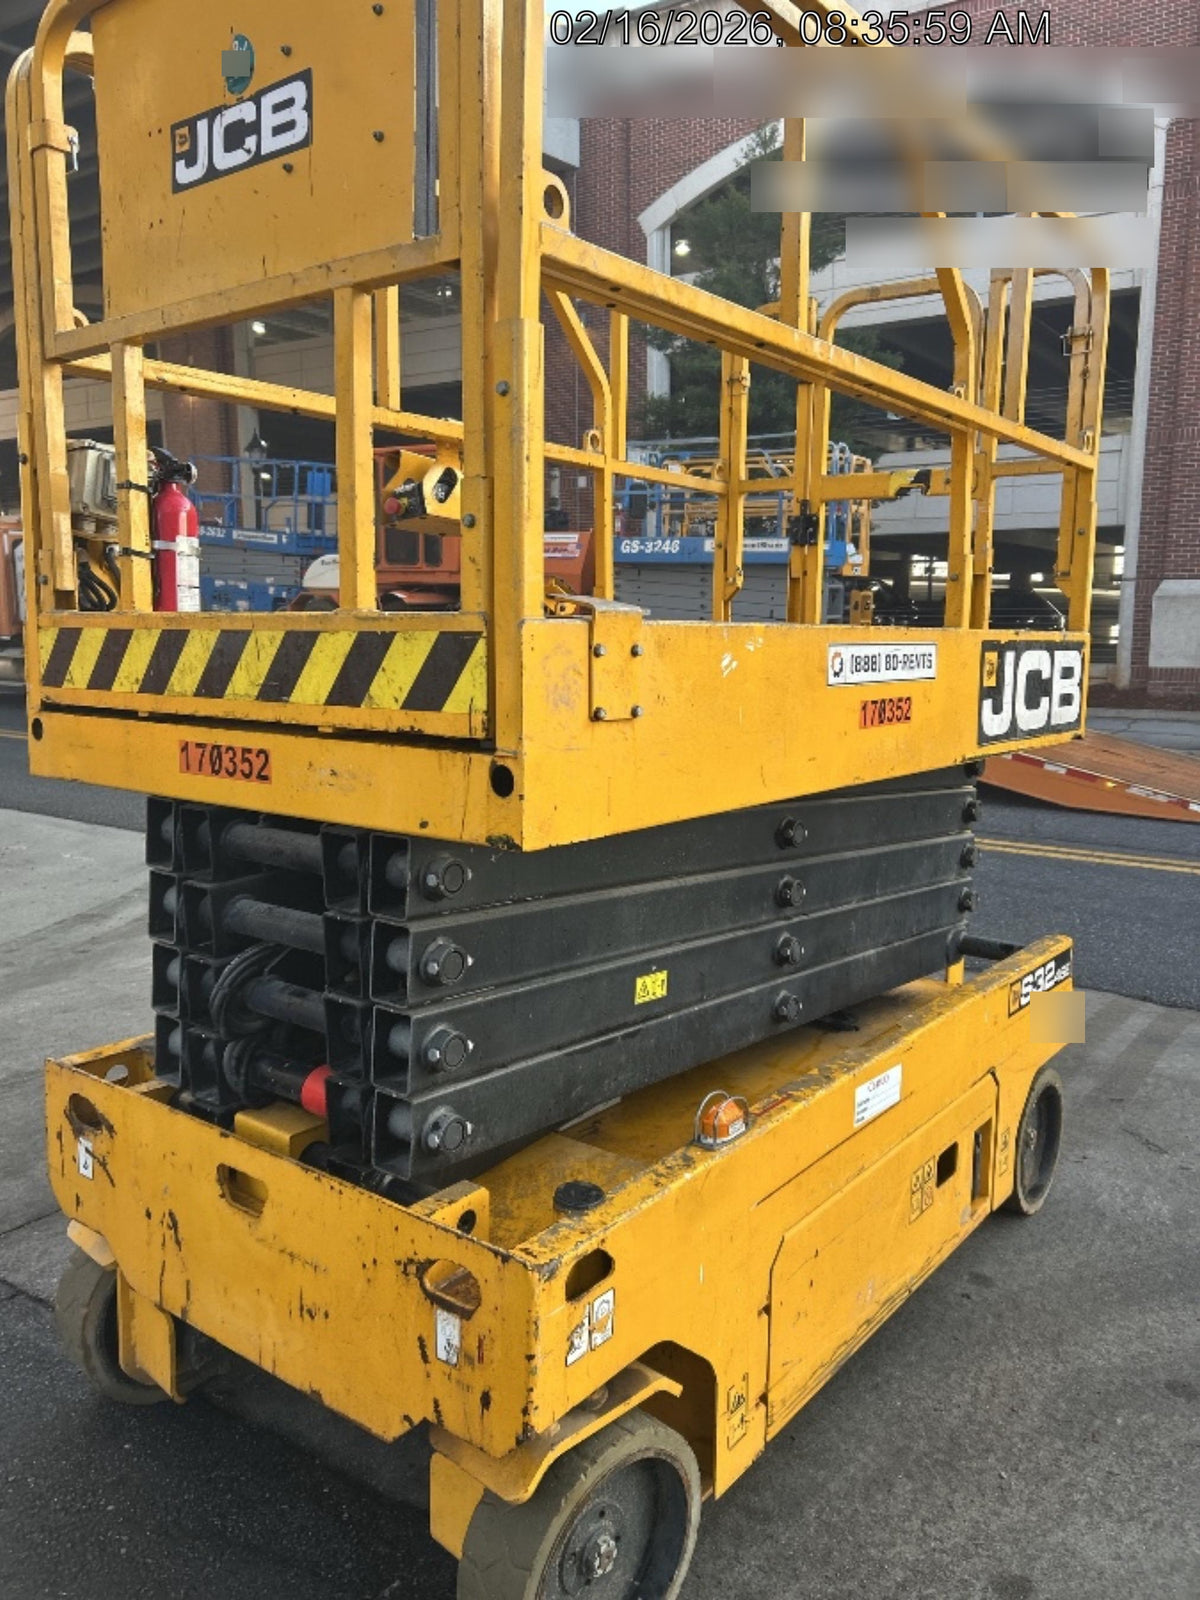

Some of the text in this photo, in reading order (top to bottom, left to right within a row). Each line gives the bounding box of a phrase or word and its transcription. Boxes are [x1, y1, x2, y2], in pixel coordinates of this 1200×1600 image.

[175, 80, 309, 184] JCB
[620, 539, 680, 554] GS-3246
[851, 652, 881, 675] (888)
[981, 650, 1082, 737] JCB
[861, 697, 911, 727] 170352
[181, 741, 269, 781] 170352
